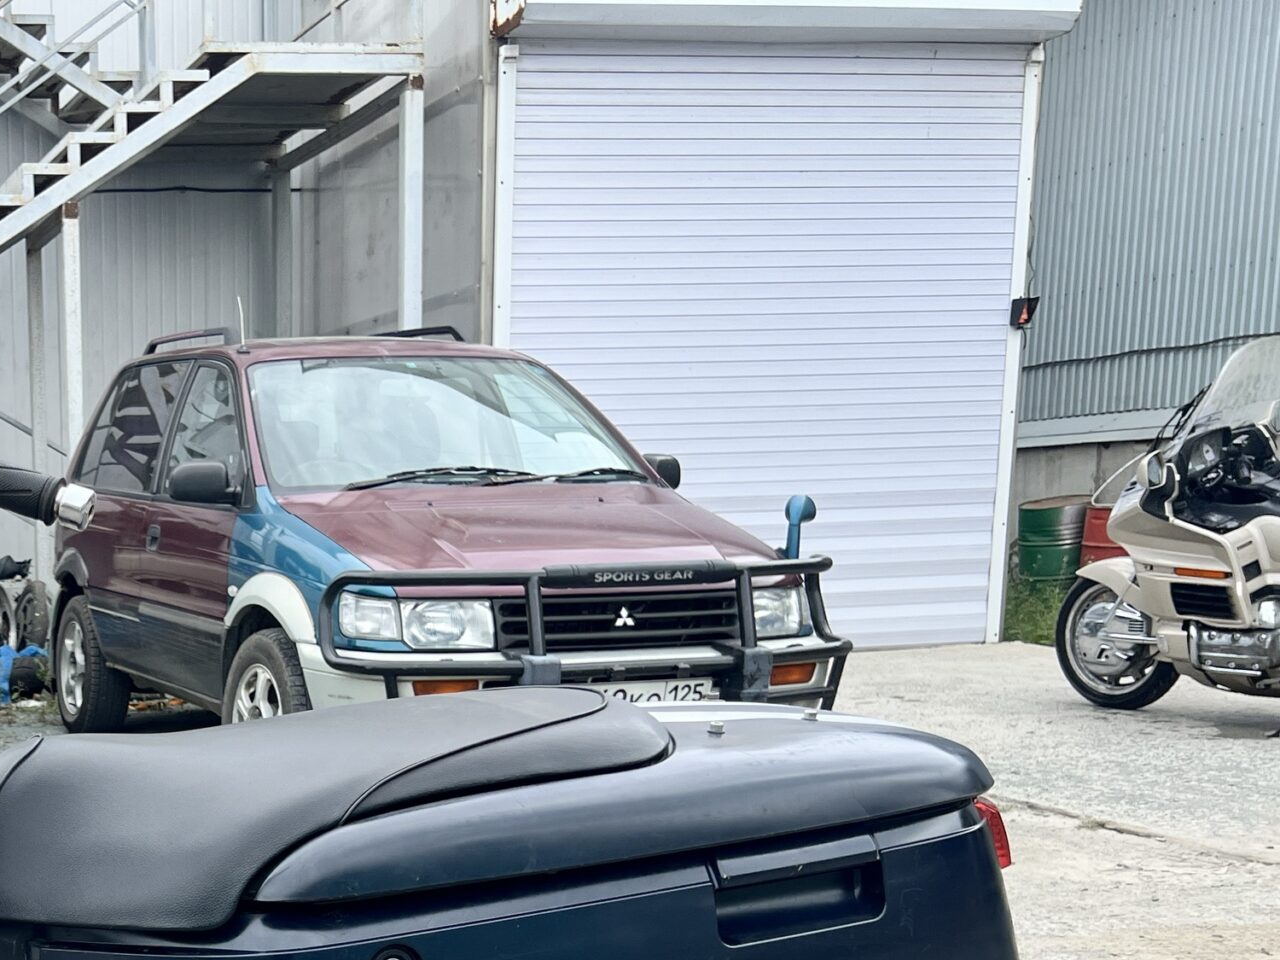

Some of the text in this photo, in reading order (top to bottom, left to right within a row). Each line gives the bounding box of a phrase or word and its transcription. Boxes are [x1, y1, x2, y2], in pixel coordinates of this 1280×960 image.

[594, 569, 694, 583] SPORTS GEAR
[668, 683, 705, 702] 125
